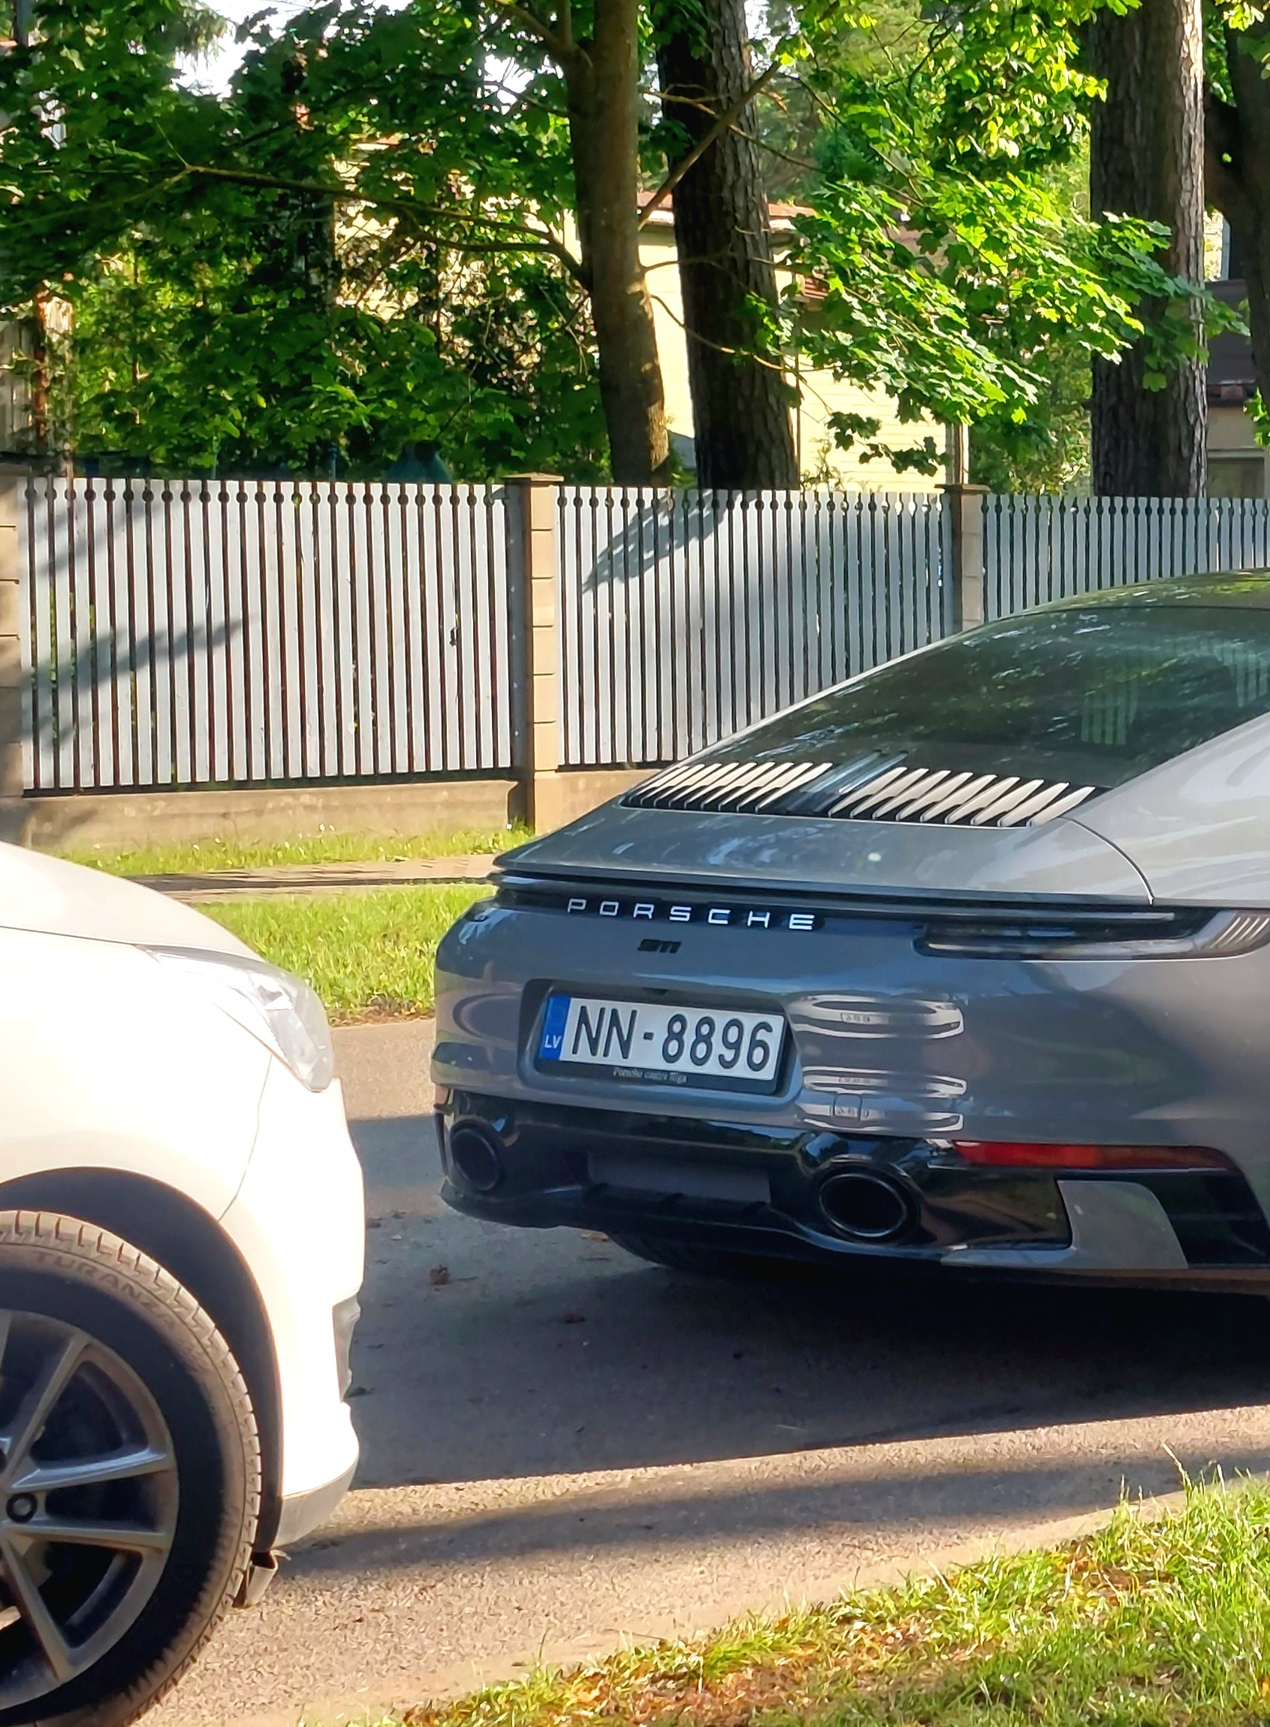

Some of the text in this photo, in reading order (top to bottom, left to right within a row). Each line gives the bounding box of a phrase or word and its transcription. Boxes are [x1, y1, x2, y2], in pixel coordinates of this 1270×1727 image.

[567, 898, 816, 931] PORSCHE
[544, 1035, 562, 1050] LV
[571, 1004, 774, 1072] NN-8896
[36, 1251, 177, 1331] TURANZA
